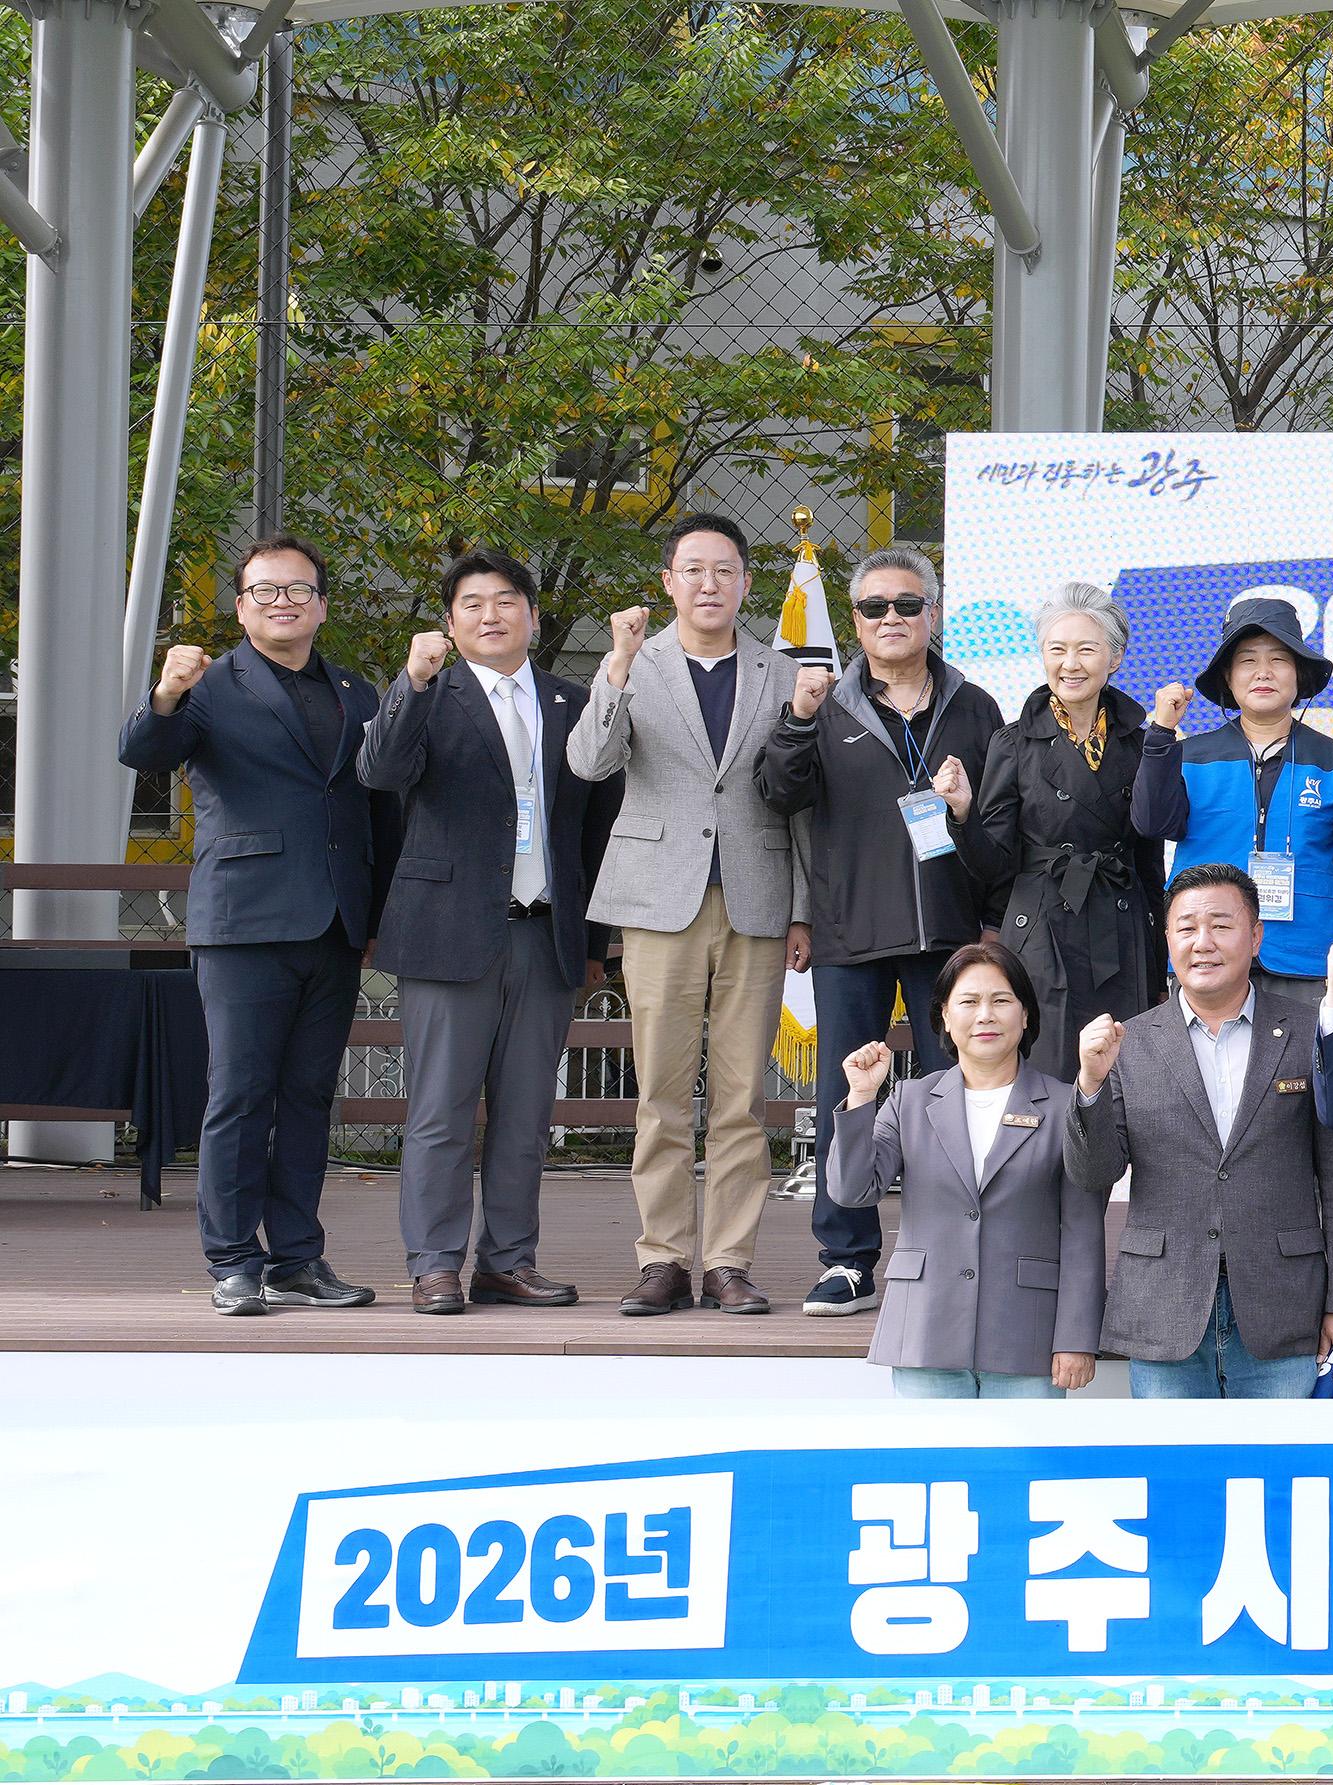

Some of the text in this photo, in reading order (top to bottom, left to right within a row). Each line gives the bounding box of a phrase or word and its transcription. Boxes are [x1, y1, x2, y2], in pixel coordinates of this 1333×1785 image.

[1127, 447, 1220, 502] 광주
[1298, 797, 1322, 805] 광주시
[331, 1505, 692, 1630] 2026년
[848, 1475, 1331, 1655] 광주시
